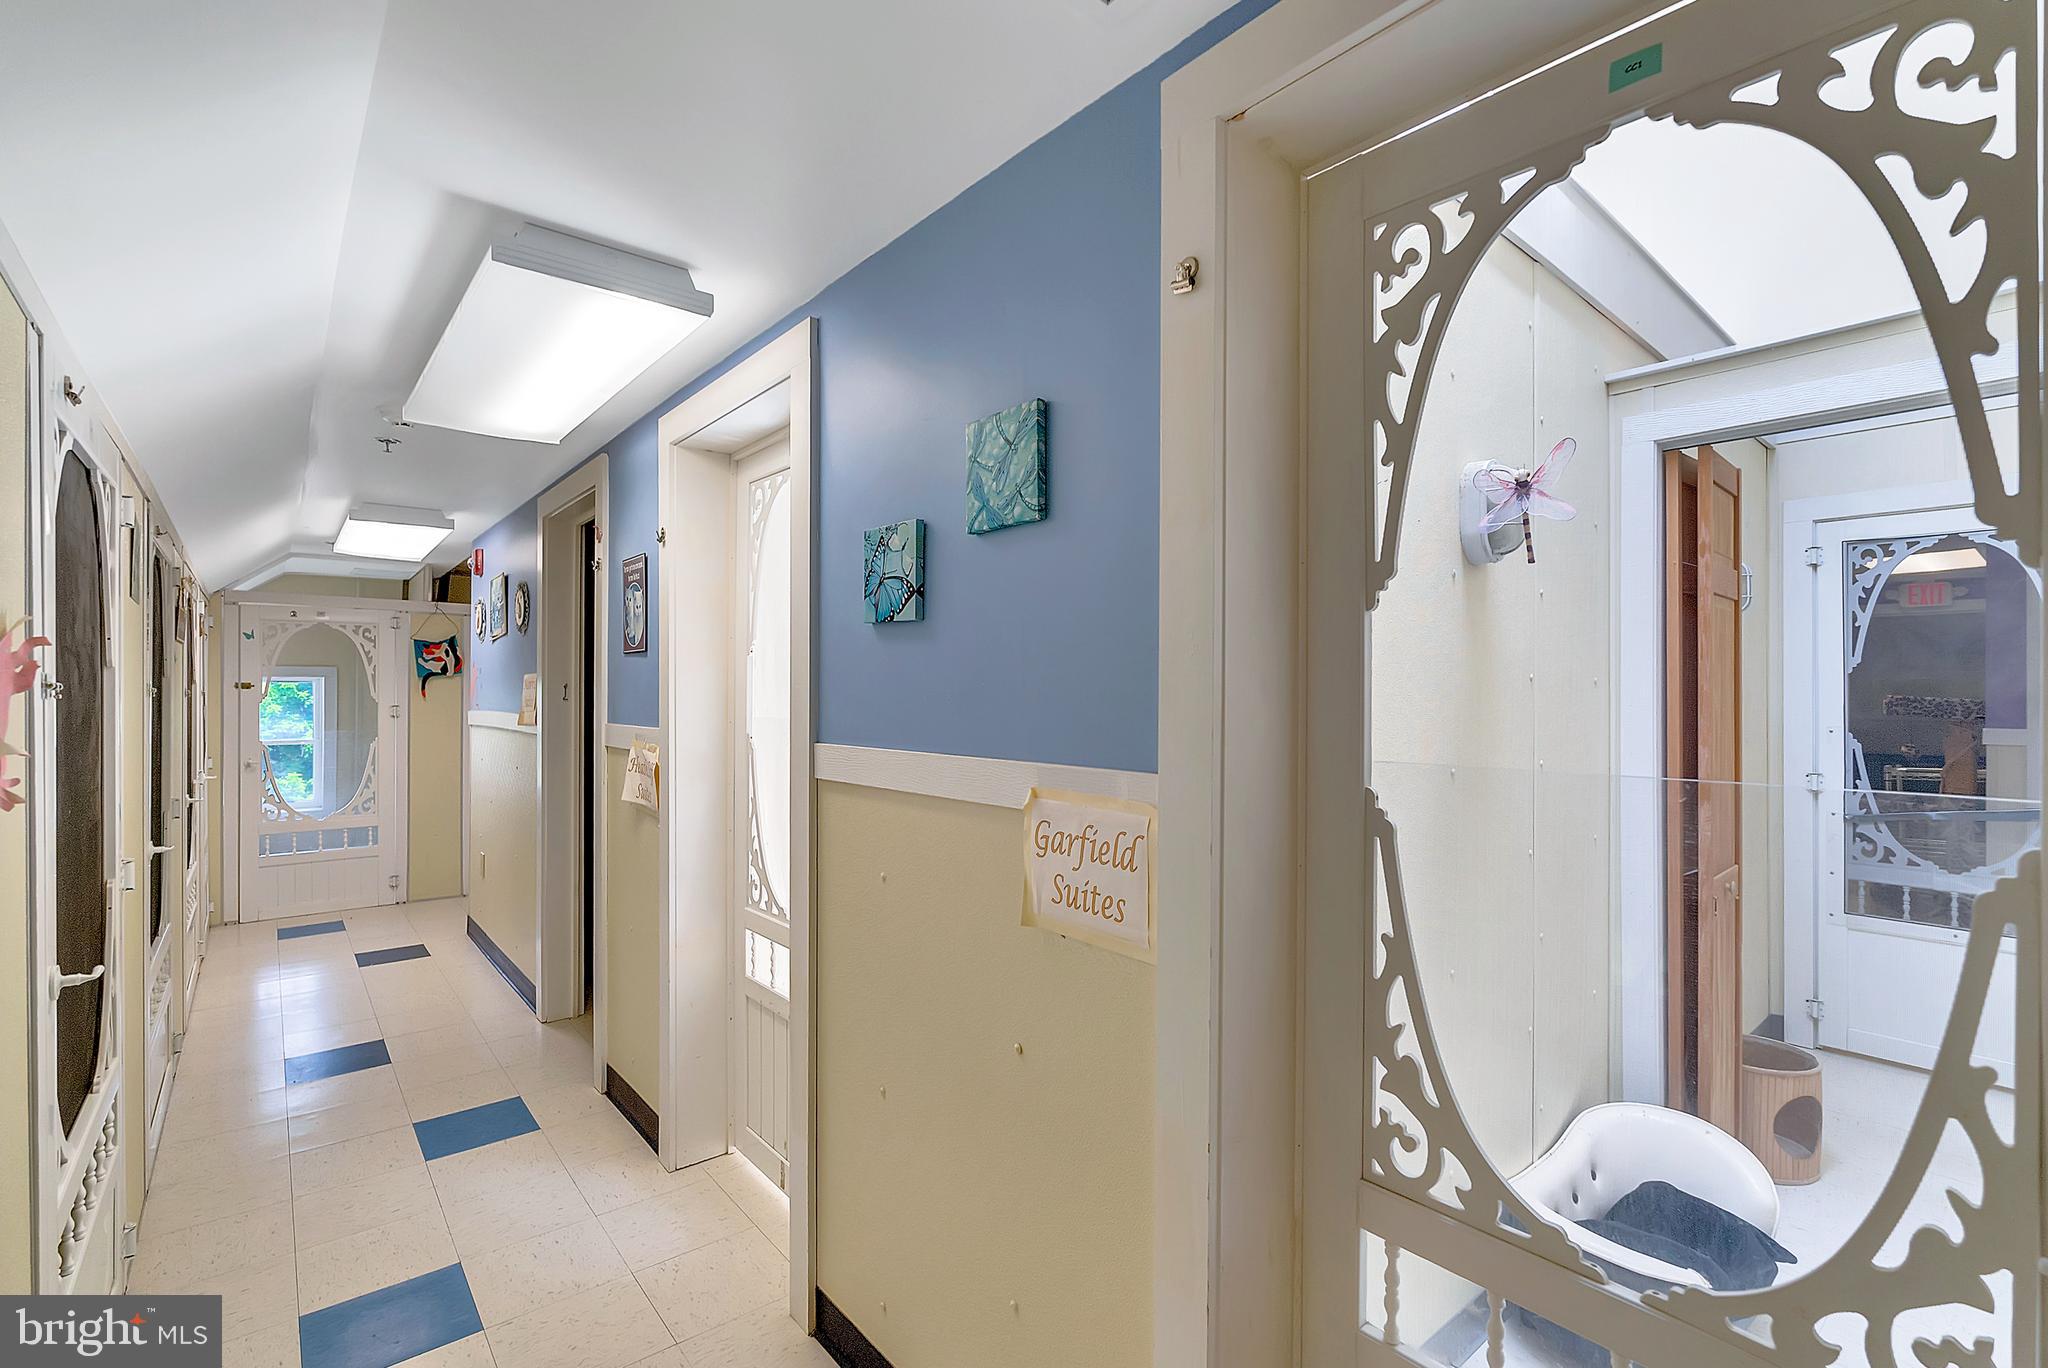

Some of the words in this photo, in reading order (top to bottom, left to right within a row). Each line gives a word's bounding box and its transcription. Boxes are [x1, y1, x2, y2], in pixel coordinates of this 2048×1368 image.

[1907, 583, 1946, 606] EXIT
[1034, 820, 1145, 872] Garfield
[1051, 873, 1126, 923] Suites
